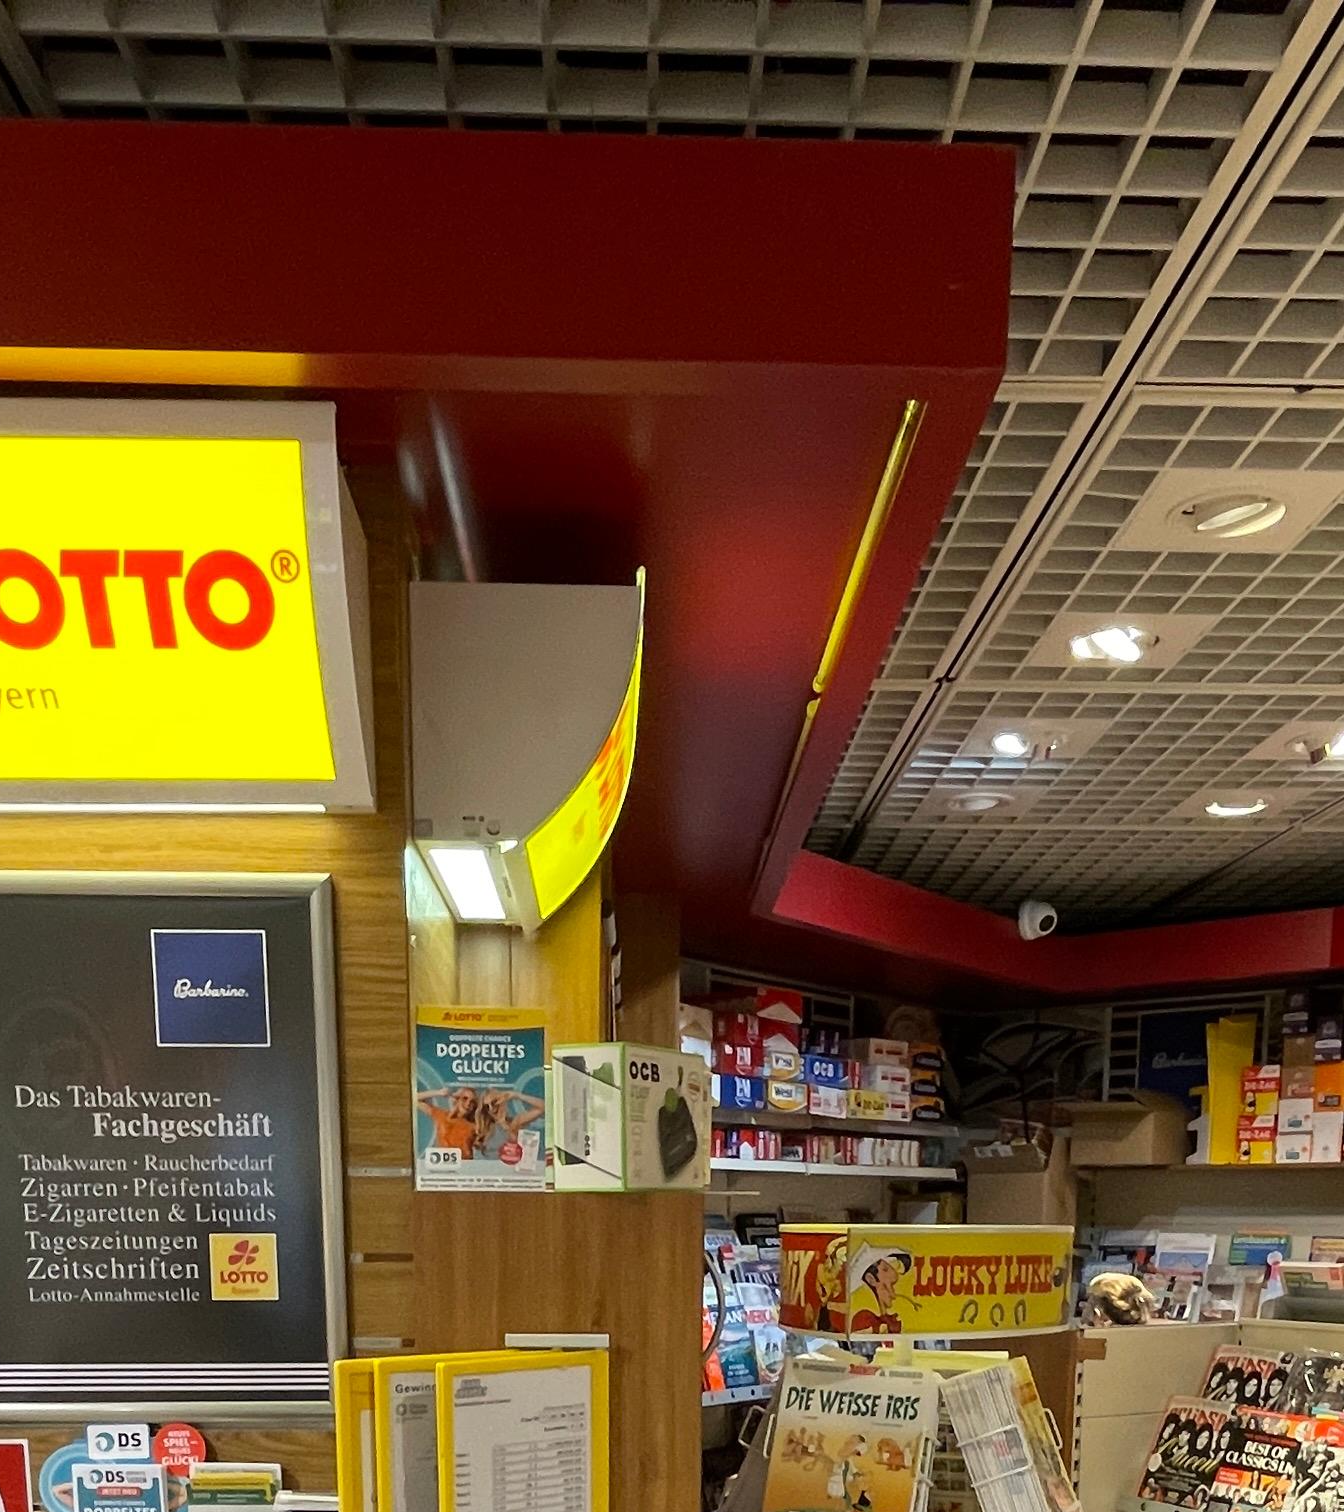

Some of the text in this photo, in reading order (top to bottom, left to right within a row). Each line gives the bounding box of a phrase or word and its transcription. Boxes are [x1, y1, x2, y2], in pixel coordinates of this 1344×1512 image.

[436, 1043, 525, 1059] DOPPELTES
[452, 1058, 509, 1075] GLÜCK!
[629, 1060, 660, 1083] OCB
[813, 1061, 835, 1078] OCB
[15, 1085, 221, 1109] Das Tabakwaren-
[93, 1113, 273, 1142] Fachgeschäft
[19, 1154, 274, 1173] Tabakwaren Raucherbedarf
[443, 1152, 458, 1163] DS
[21, 1178, 275, 1202] Zigarren Pfeifentabak
[24, 1203, 277, 1228] E-Zigaretten & Liquids
[25, 1231, 198, 1257] Tageszeitungen
[27, 1256, 200, 1281] Zeitschriften
[220, 1270, 268, 1285] LOTTO
[912, 1255, 1054, 1297] LUCKY LUKE
[29, 1286, 200, 1303] Lotto-Annahmestelle
[785, 1385, 921, 1421] DIE WEISSE IRIS
[118, 1433, 142, 1447] DS
[1245, 1440, 1290, 1460] BEST OF
[105, 1471, 125, 1483] DS
